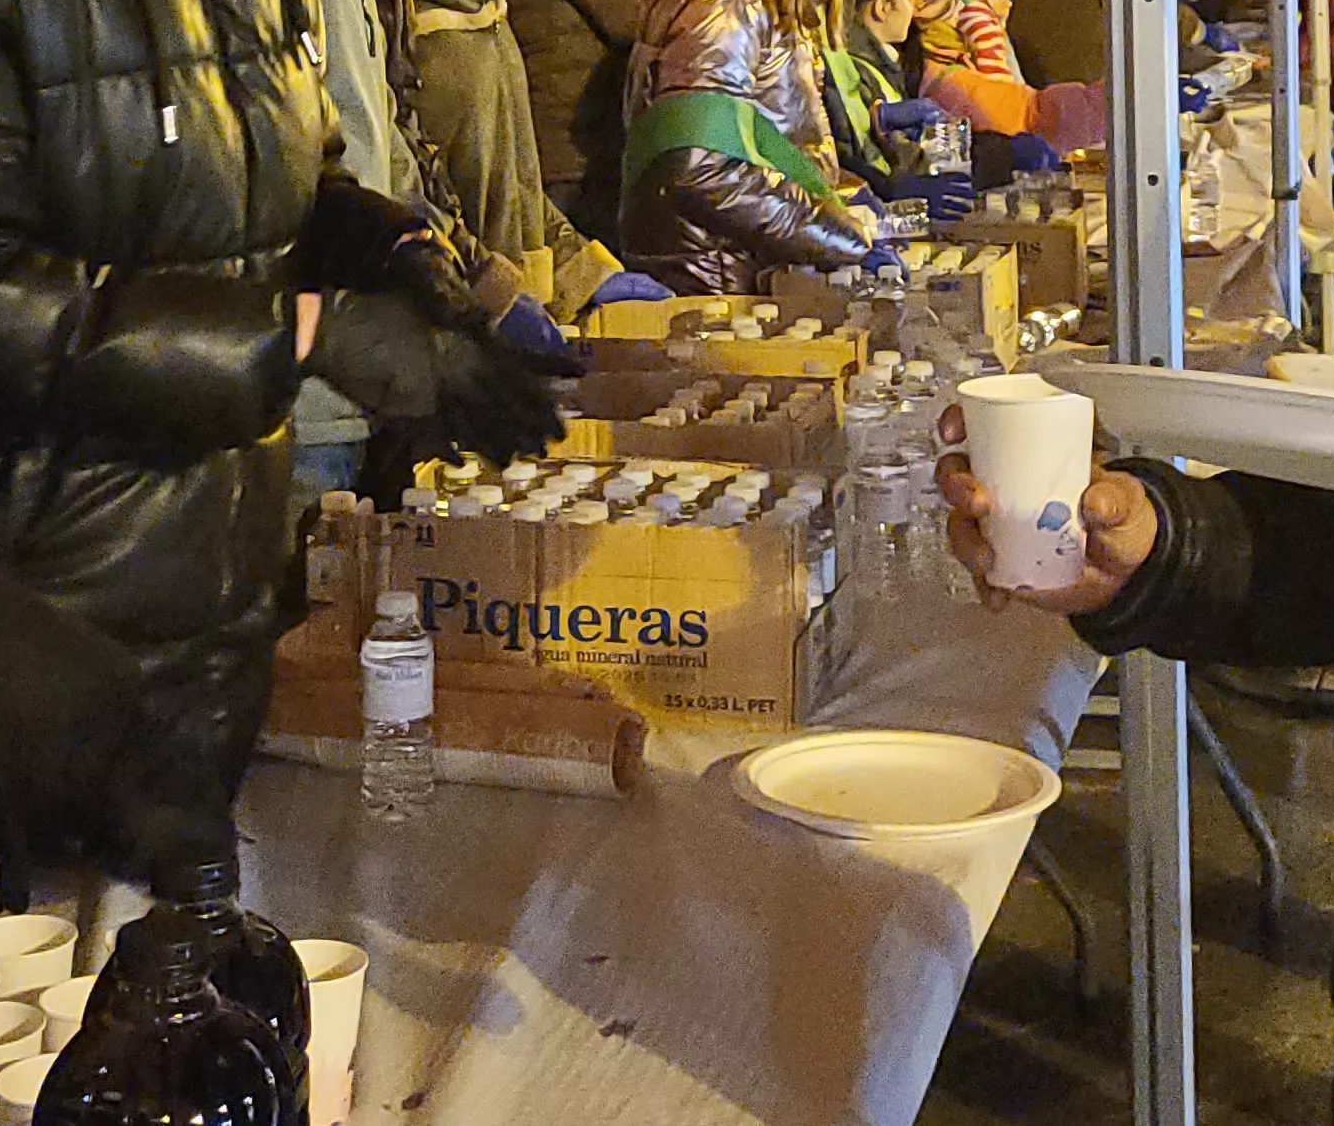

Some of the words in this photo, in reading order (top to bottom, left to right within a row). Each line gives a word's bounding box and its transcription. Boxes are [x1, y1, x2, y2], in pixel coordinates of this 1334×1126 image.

[417, 577, 709, 651] Piqueras
[576, 647, 640, 665] mineral
[646, 651, 709, 668] natural
[748, 699, 777, 714] PET
